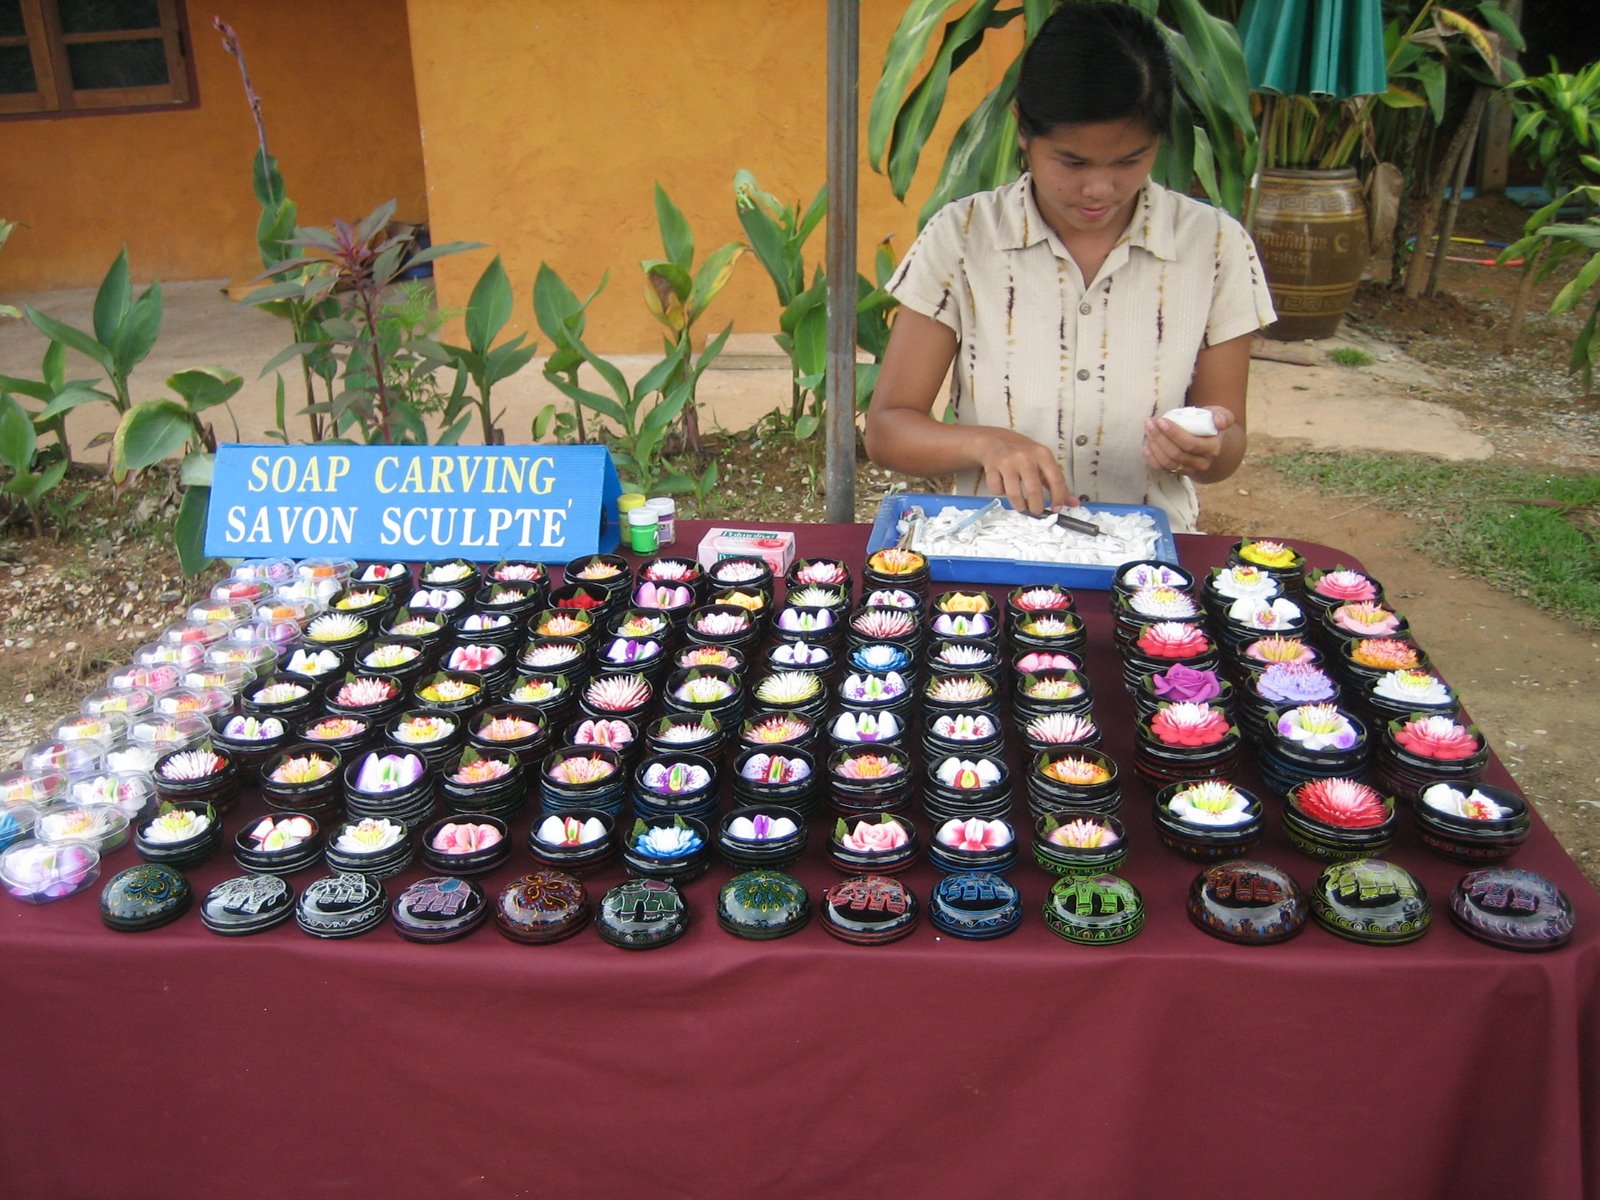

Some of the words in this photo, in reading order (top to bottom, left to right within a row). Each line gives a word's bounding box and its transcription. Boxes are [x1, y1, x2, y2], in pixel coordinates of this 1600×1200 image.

[247, 455, 351, 493] SOAP
[374, 456, 556, 494] CARVING
[225, 505, 358, 545] SAVON
